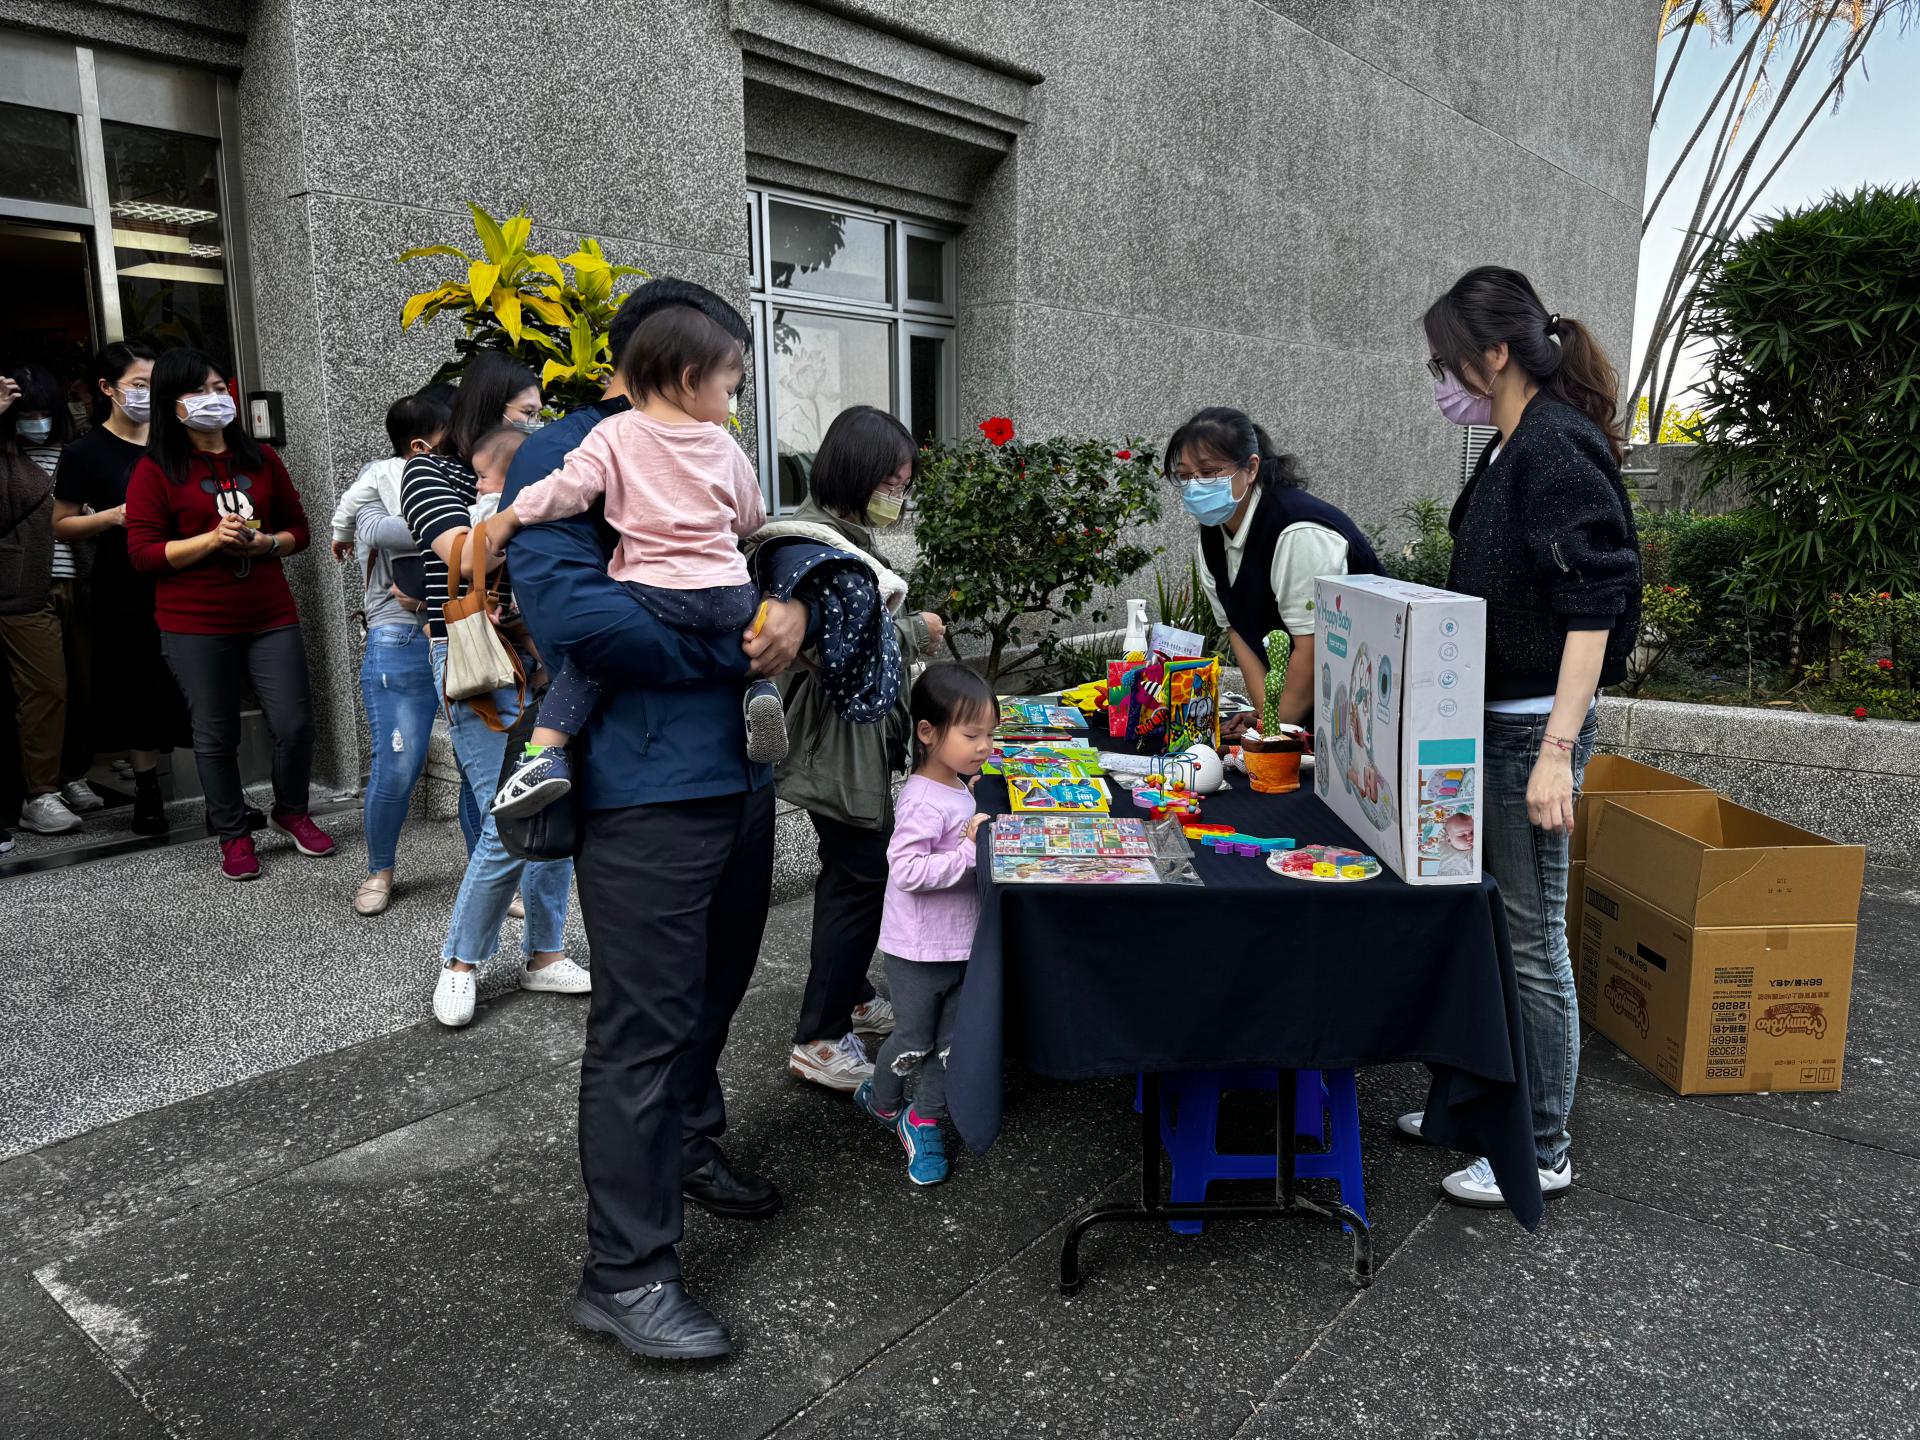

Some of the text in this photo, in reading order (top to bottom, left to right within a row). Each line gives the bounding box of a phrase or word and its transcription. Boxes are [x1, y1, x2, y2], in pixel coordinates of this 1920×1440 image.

[1712, 1001, 1751, 1010] 128280
[1755, 1014, 1827, 1040] MamyPoko
[1707, 1068, 1743, 1077] 12828
